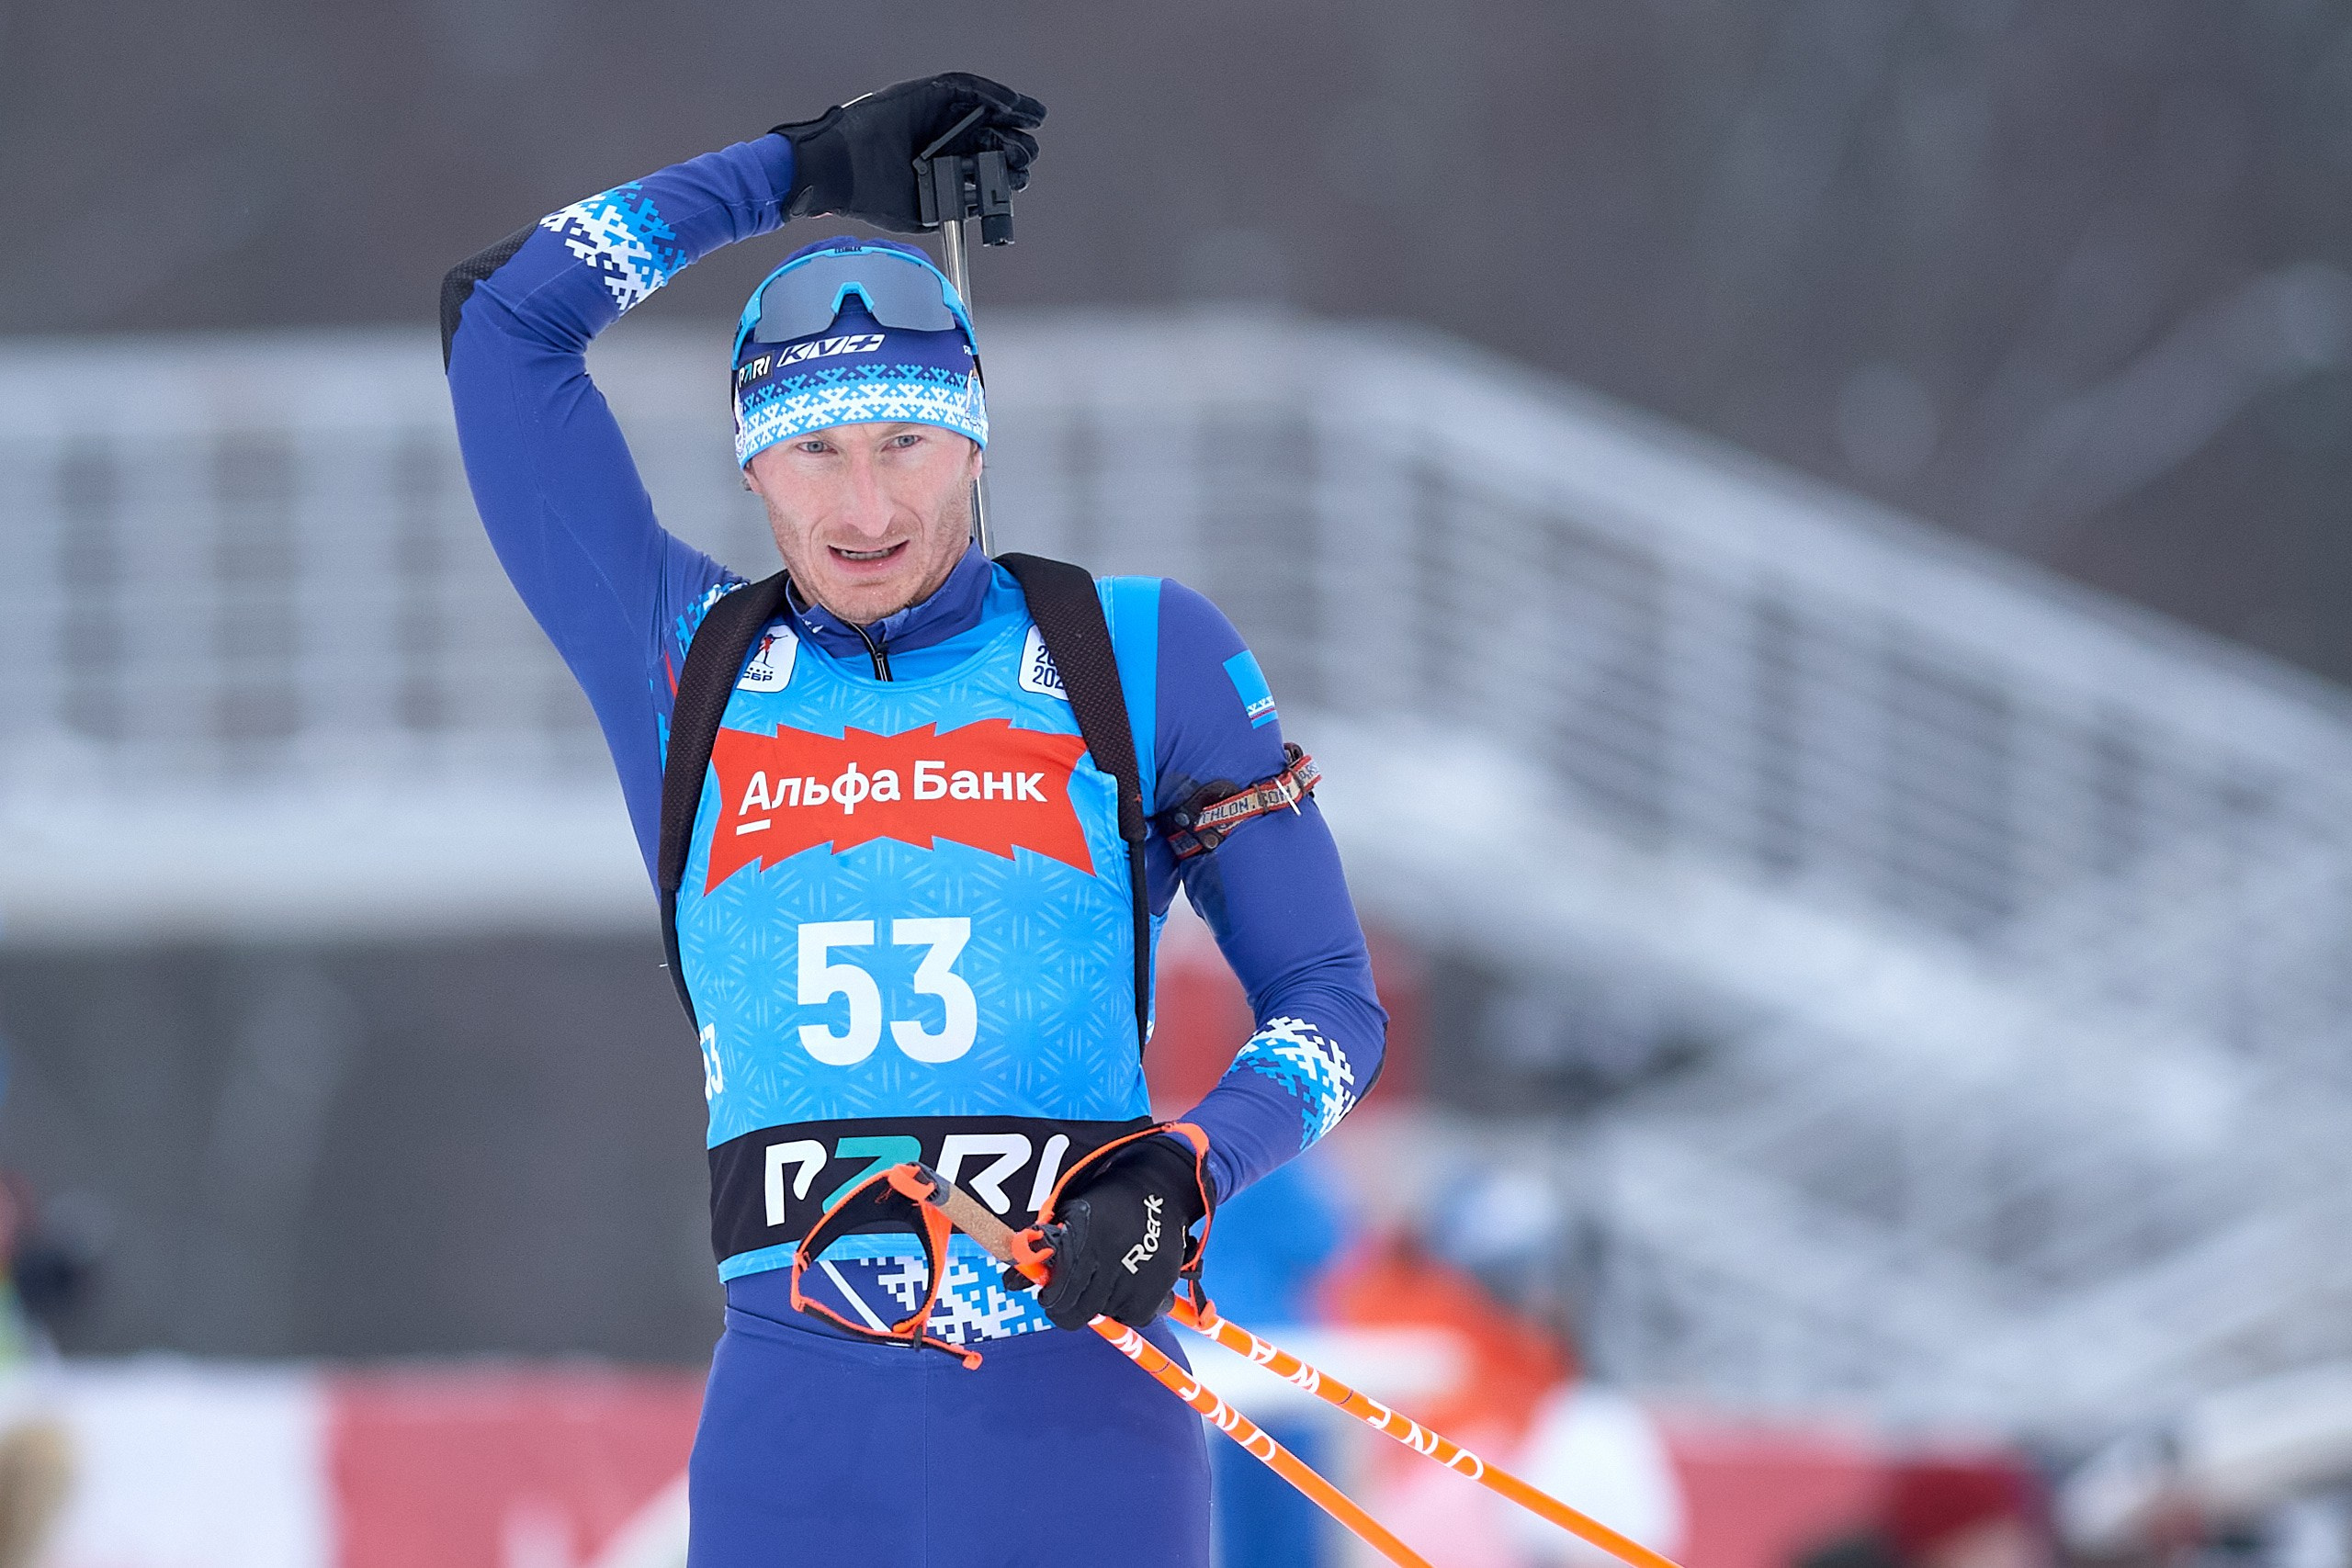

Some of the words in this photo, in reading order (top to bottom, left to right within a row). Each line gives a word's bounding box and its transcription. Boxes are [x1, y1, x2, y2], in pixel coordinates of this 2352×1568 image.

[739, 355, 771, 388] PARI
[739, 761, 901, 815] Альфа
[913, 760, 1048, 803] Банк
[1199, 787, 1294, 824] THLON.COM
[797, 917, 978, 1066] 53
